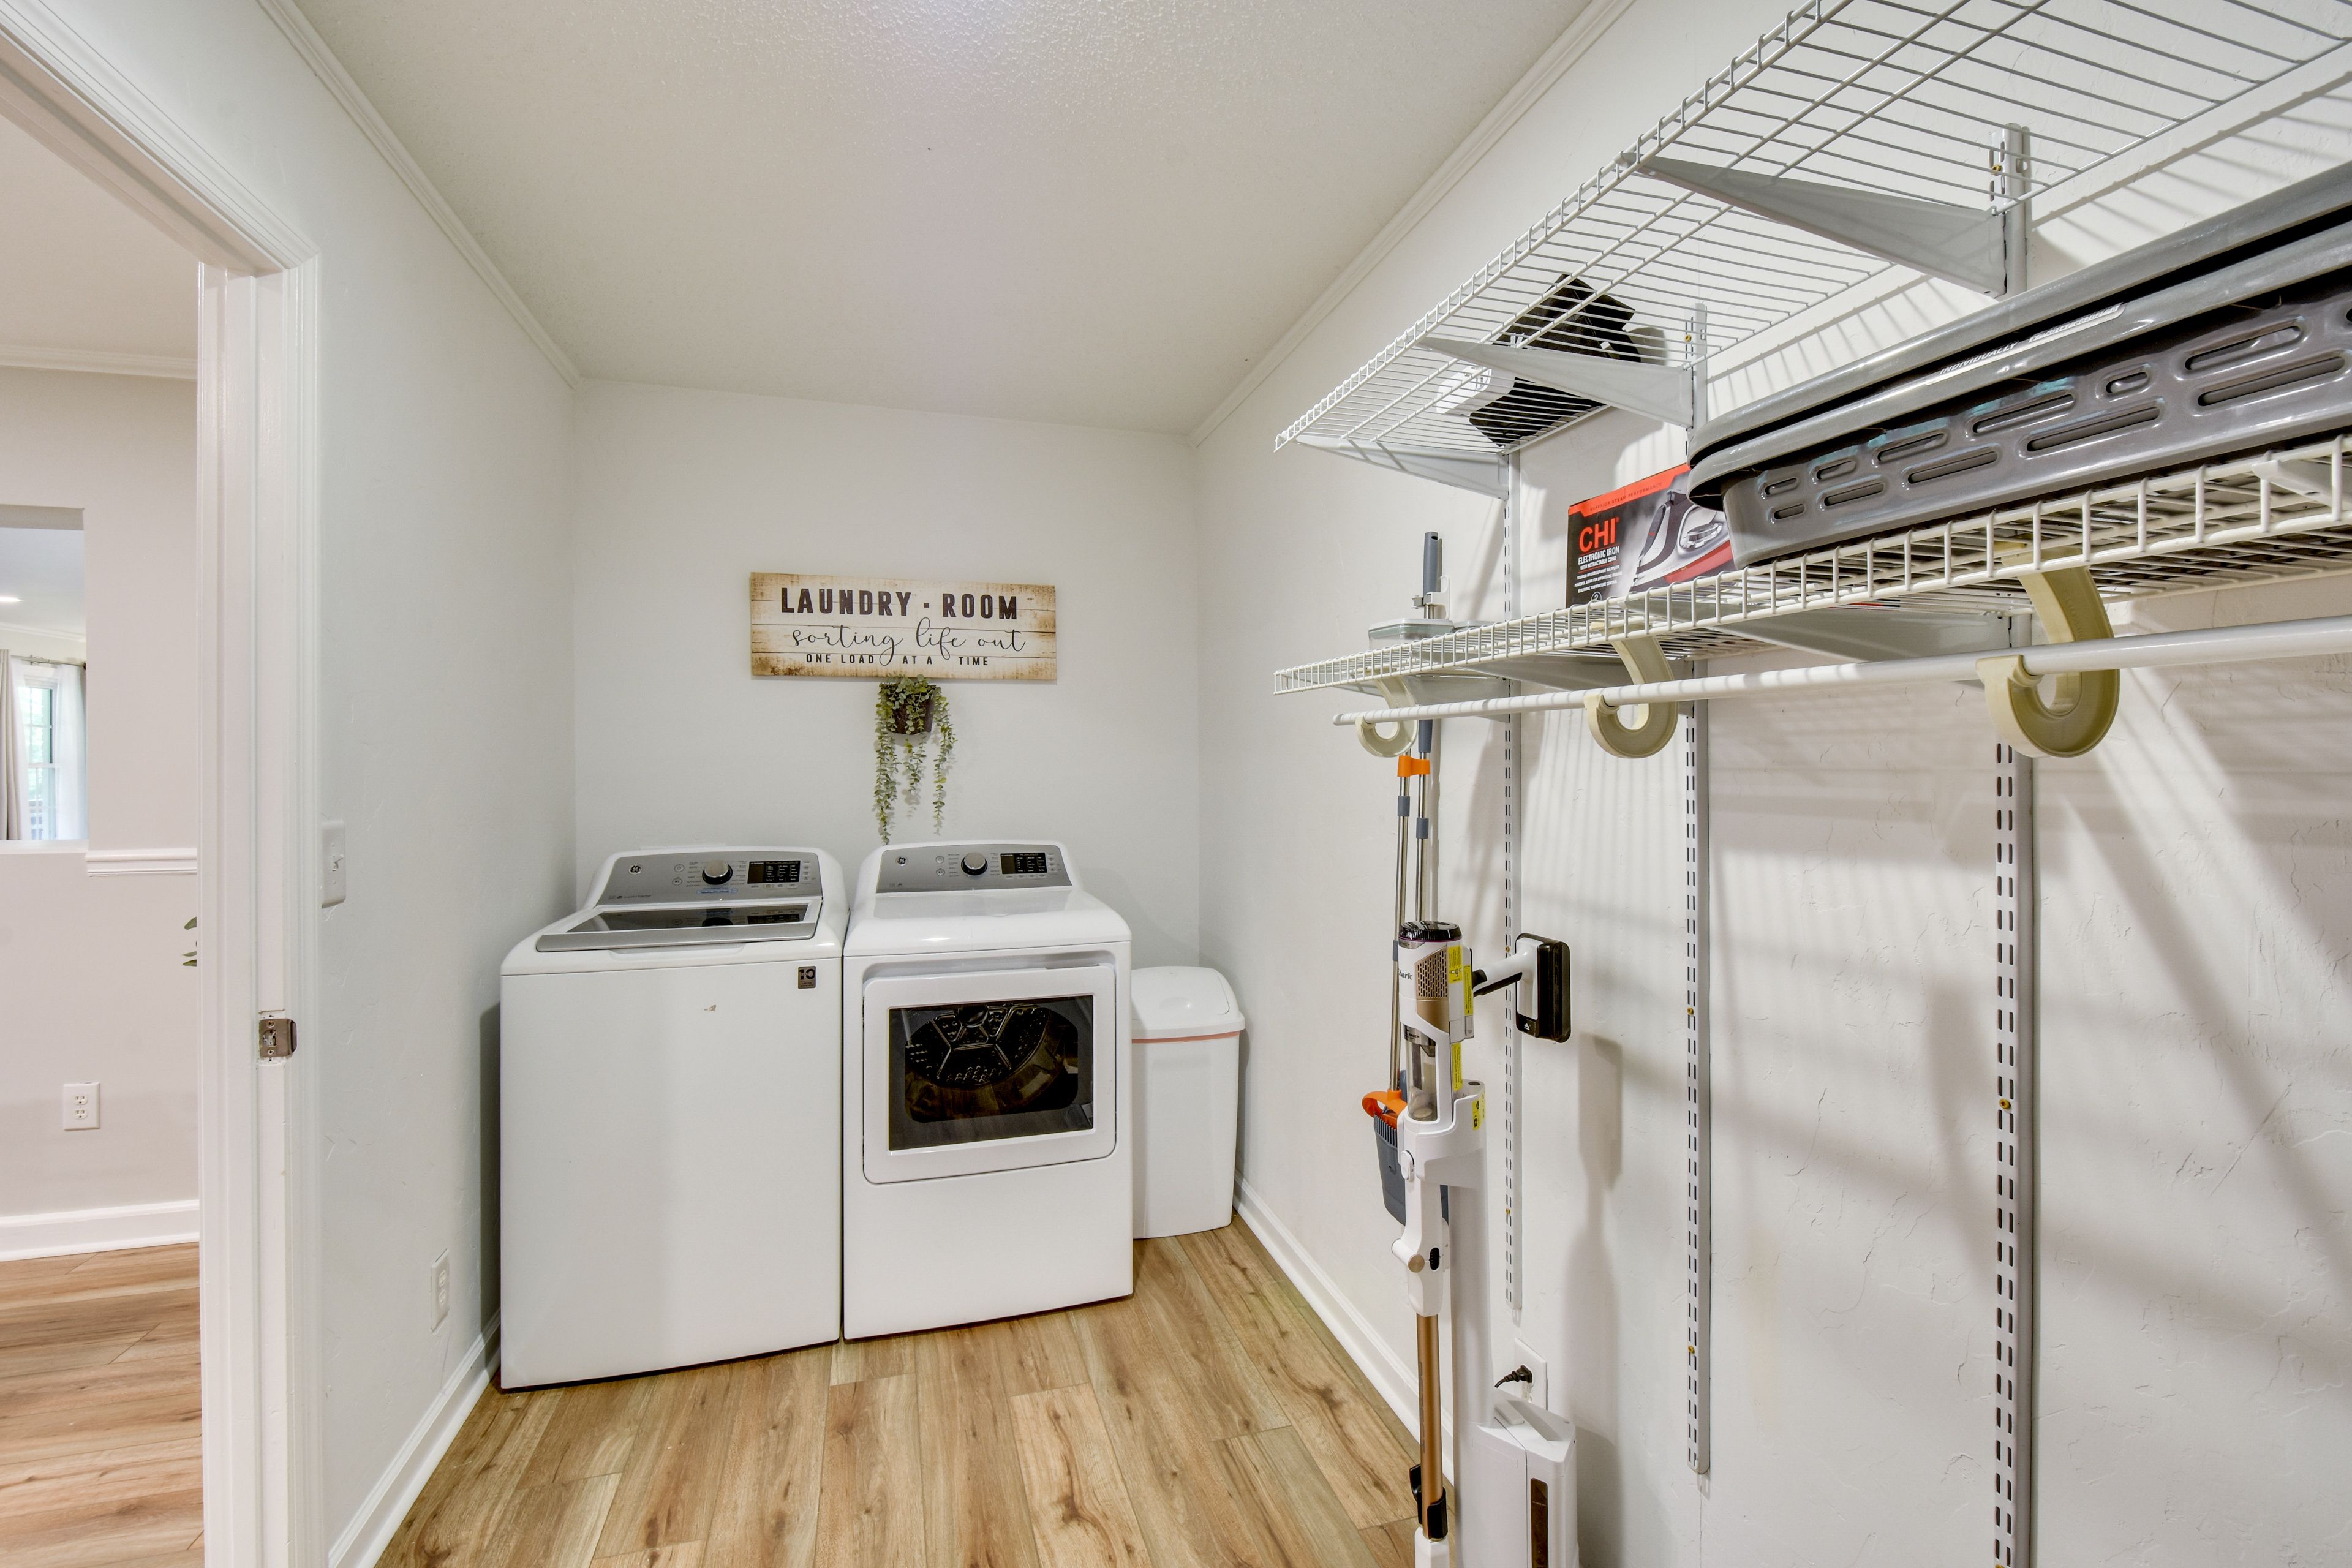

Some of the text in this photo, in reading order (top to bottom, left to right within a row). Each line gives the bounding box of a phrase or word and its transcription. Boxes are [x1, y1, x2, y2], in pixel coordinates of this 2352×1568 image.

[1939, 341, 2019, 375] INDIVIDUALLY
[1611, 495, 1627, 504] STEAM
[1628, 482, 1662, 498] PERFORMANCE
[1579, 518, 1616, 552] CHI
[1578, 545, 1620, 565] ELECTRONIC IRON
[781, 587, 1017, 620] LAUNDRY ROOM
[792, 617, 1026, 666] sorting life out
[806, 654, 989, 666] ONE LOAD AT A TIME
[1398, 970, 1412, 980] hark
